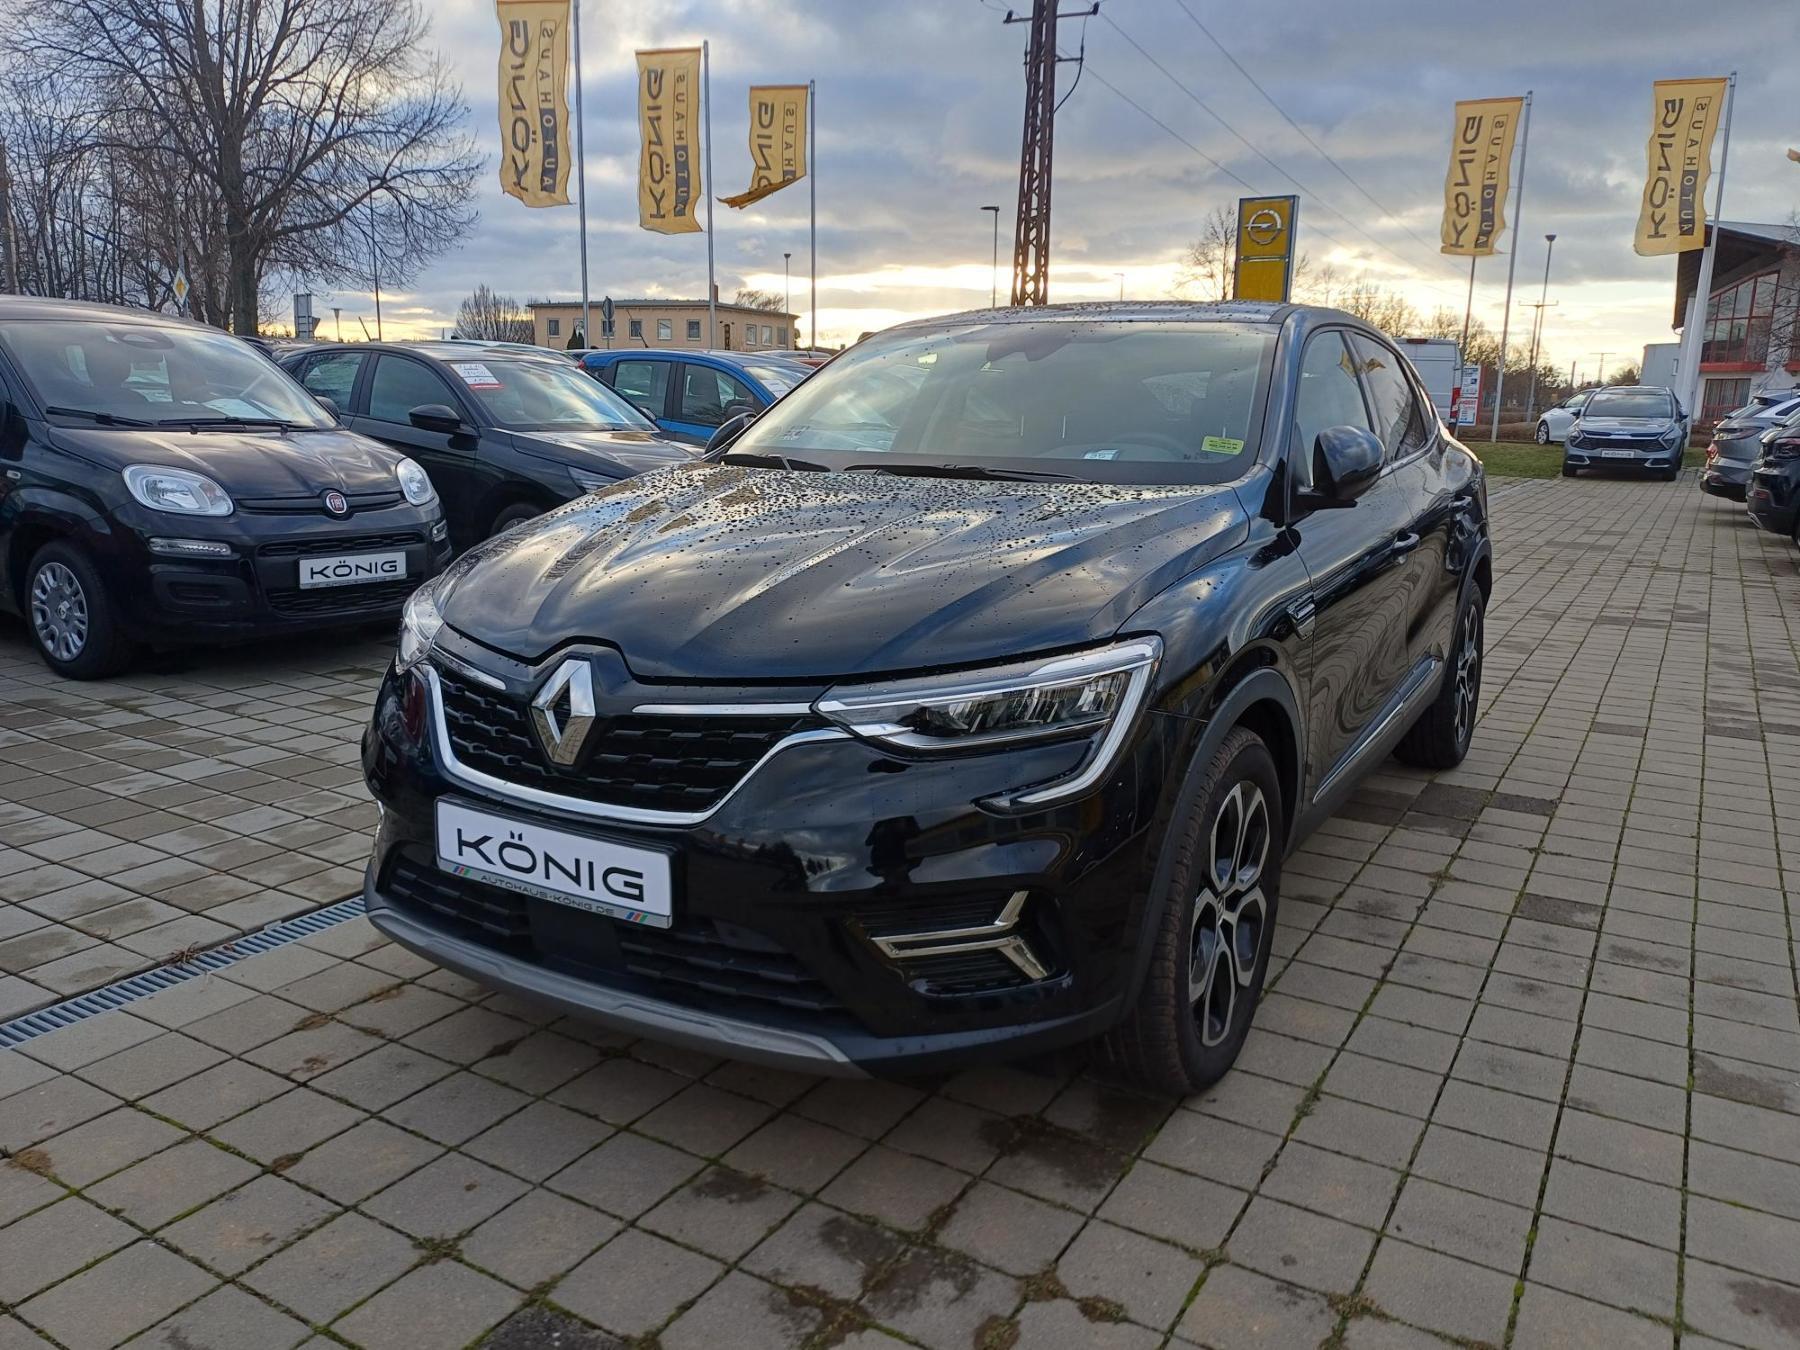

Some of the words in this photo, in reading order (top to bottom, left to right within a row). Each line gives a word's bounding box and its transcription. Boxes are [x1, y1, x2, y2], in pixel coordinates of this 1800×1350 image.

[310, 560, 398, 580] KÖNIG
[456, 827, 645, 903] KÖNIG
[480, 874, 615, 916] AUTOHAUS-KÖNIGDE
